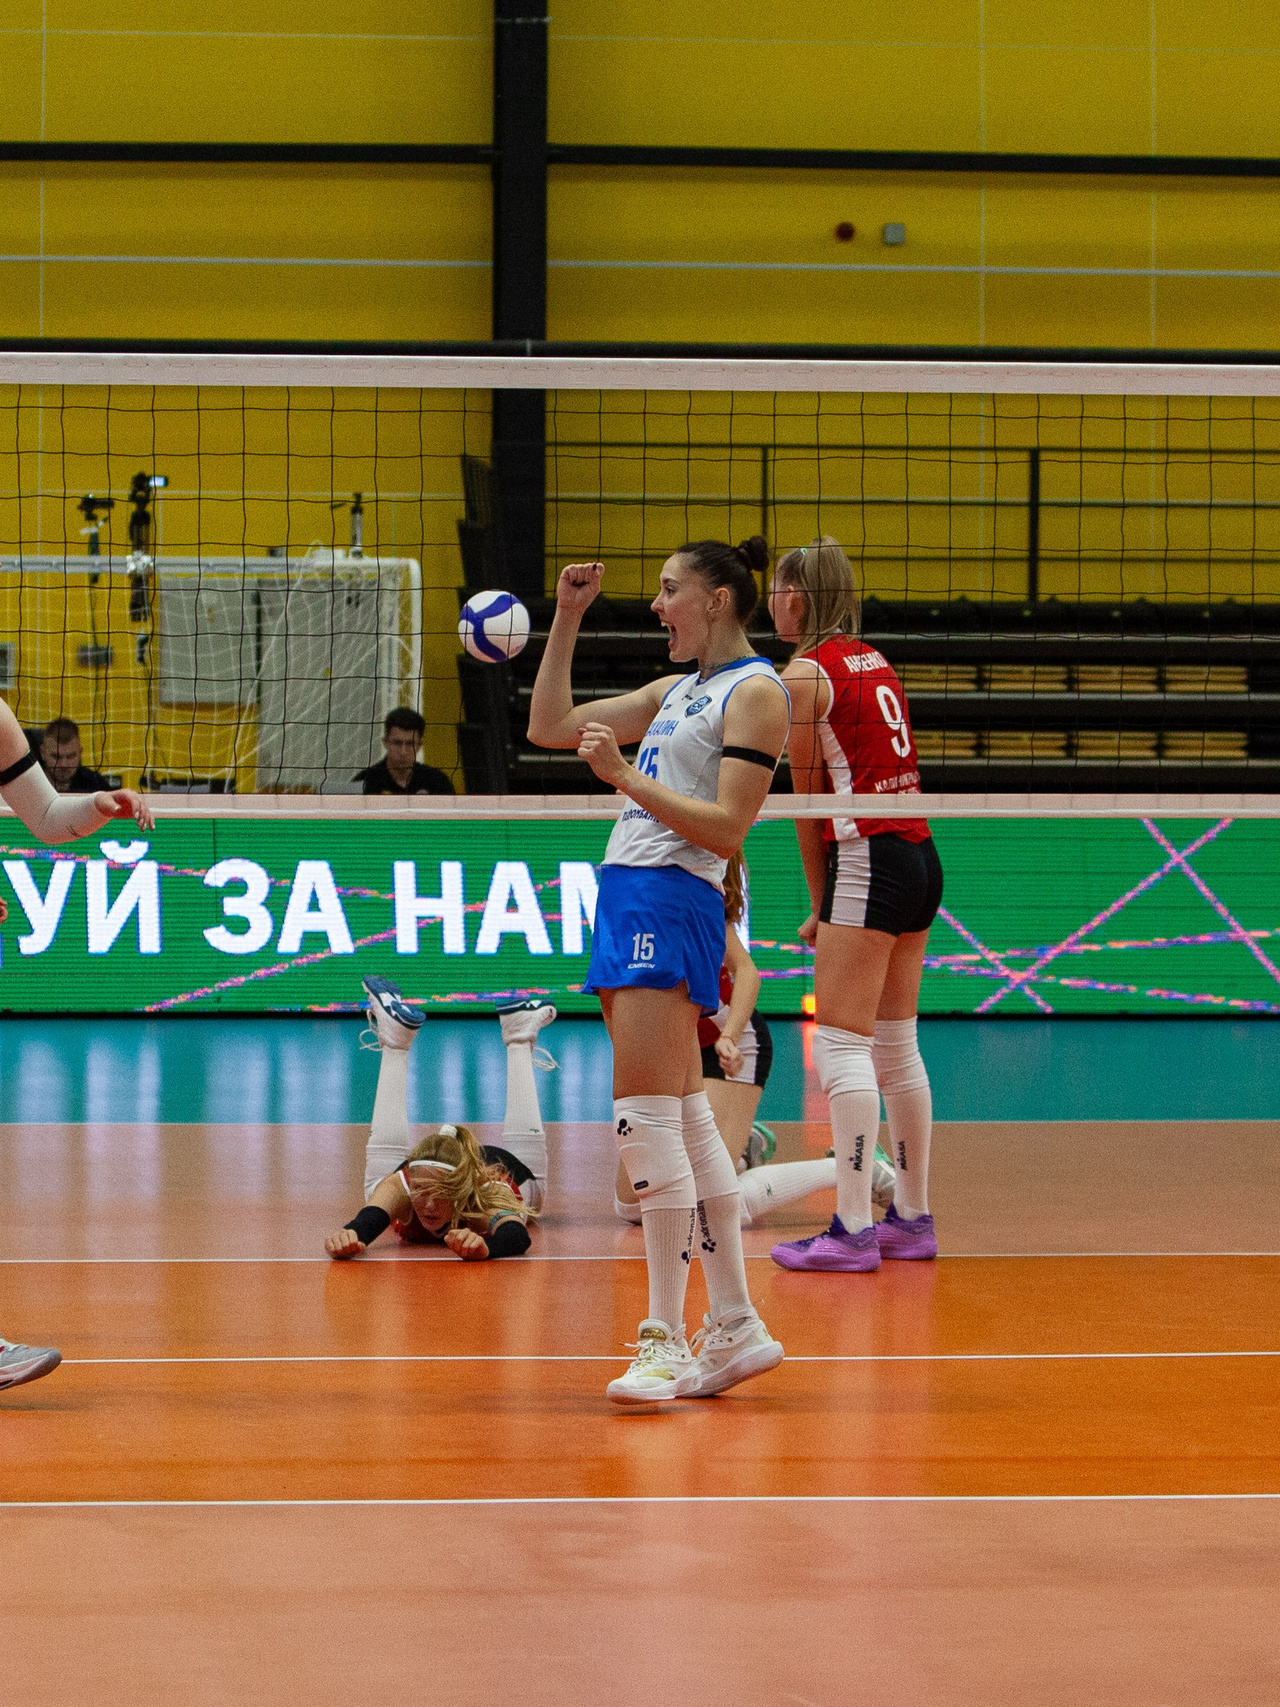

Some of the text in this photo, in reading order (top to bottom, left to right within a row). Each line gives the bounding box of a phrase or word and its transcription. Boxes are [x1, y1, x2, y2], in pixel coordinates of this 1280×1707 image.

[876, 685, 911, 758] 9
[203, 858, 355, 955] ЗА
[632, 933, 655, 961] 15
